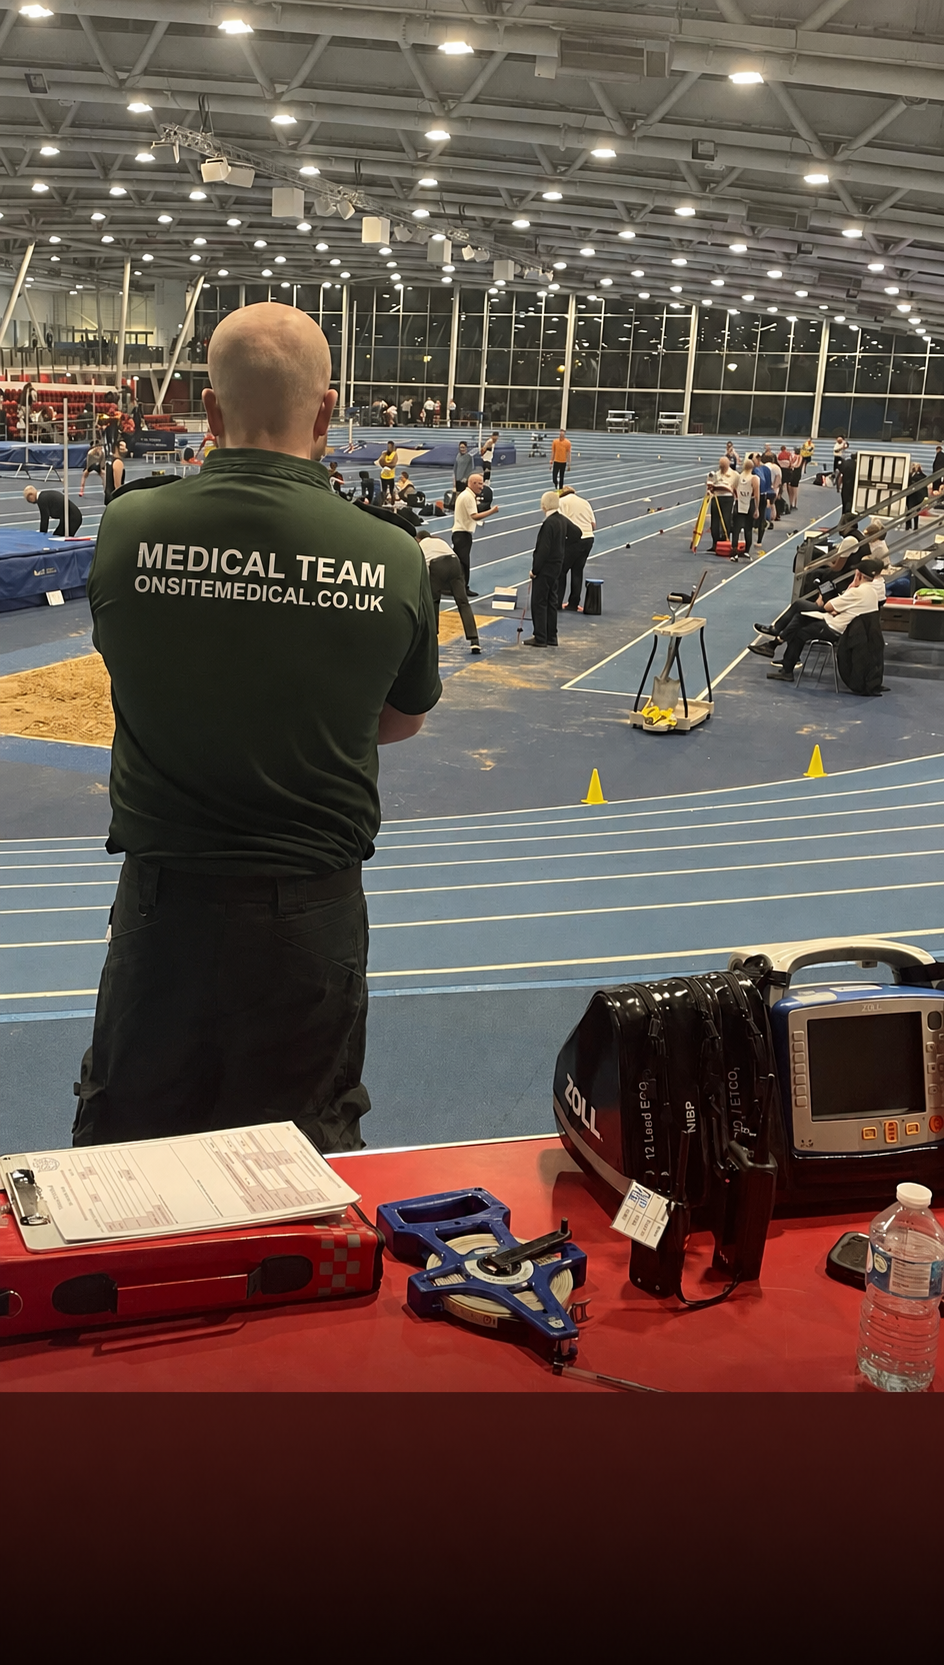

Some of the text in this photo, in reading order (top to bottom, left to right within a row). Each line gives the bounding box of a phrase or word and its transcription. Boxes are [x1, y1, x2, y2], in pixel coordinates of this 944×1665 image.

[137, 542, 386, 589] MEDICAL TEAM
[134, 574, 384, 613] ONSITEMEDICAL.CO.UK
[862, 1003, 882, 1012] ZOLL
[564, 1072, 601, 1140] ZOLL
[685, 1101, 696, 1133] NIBP
[640, 1112, 654, 1143] Lead
[644, 1146, 656, 1160] 12
